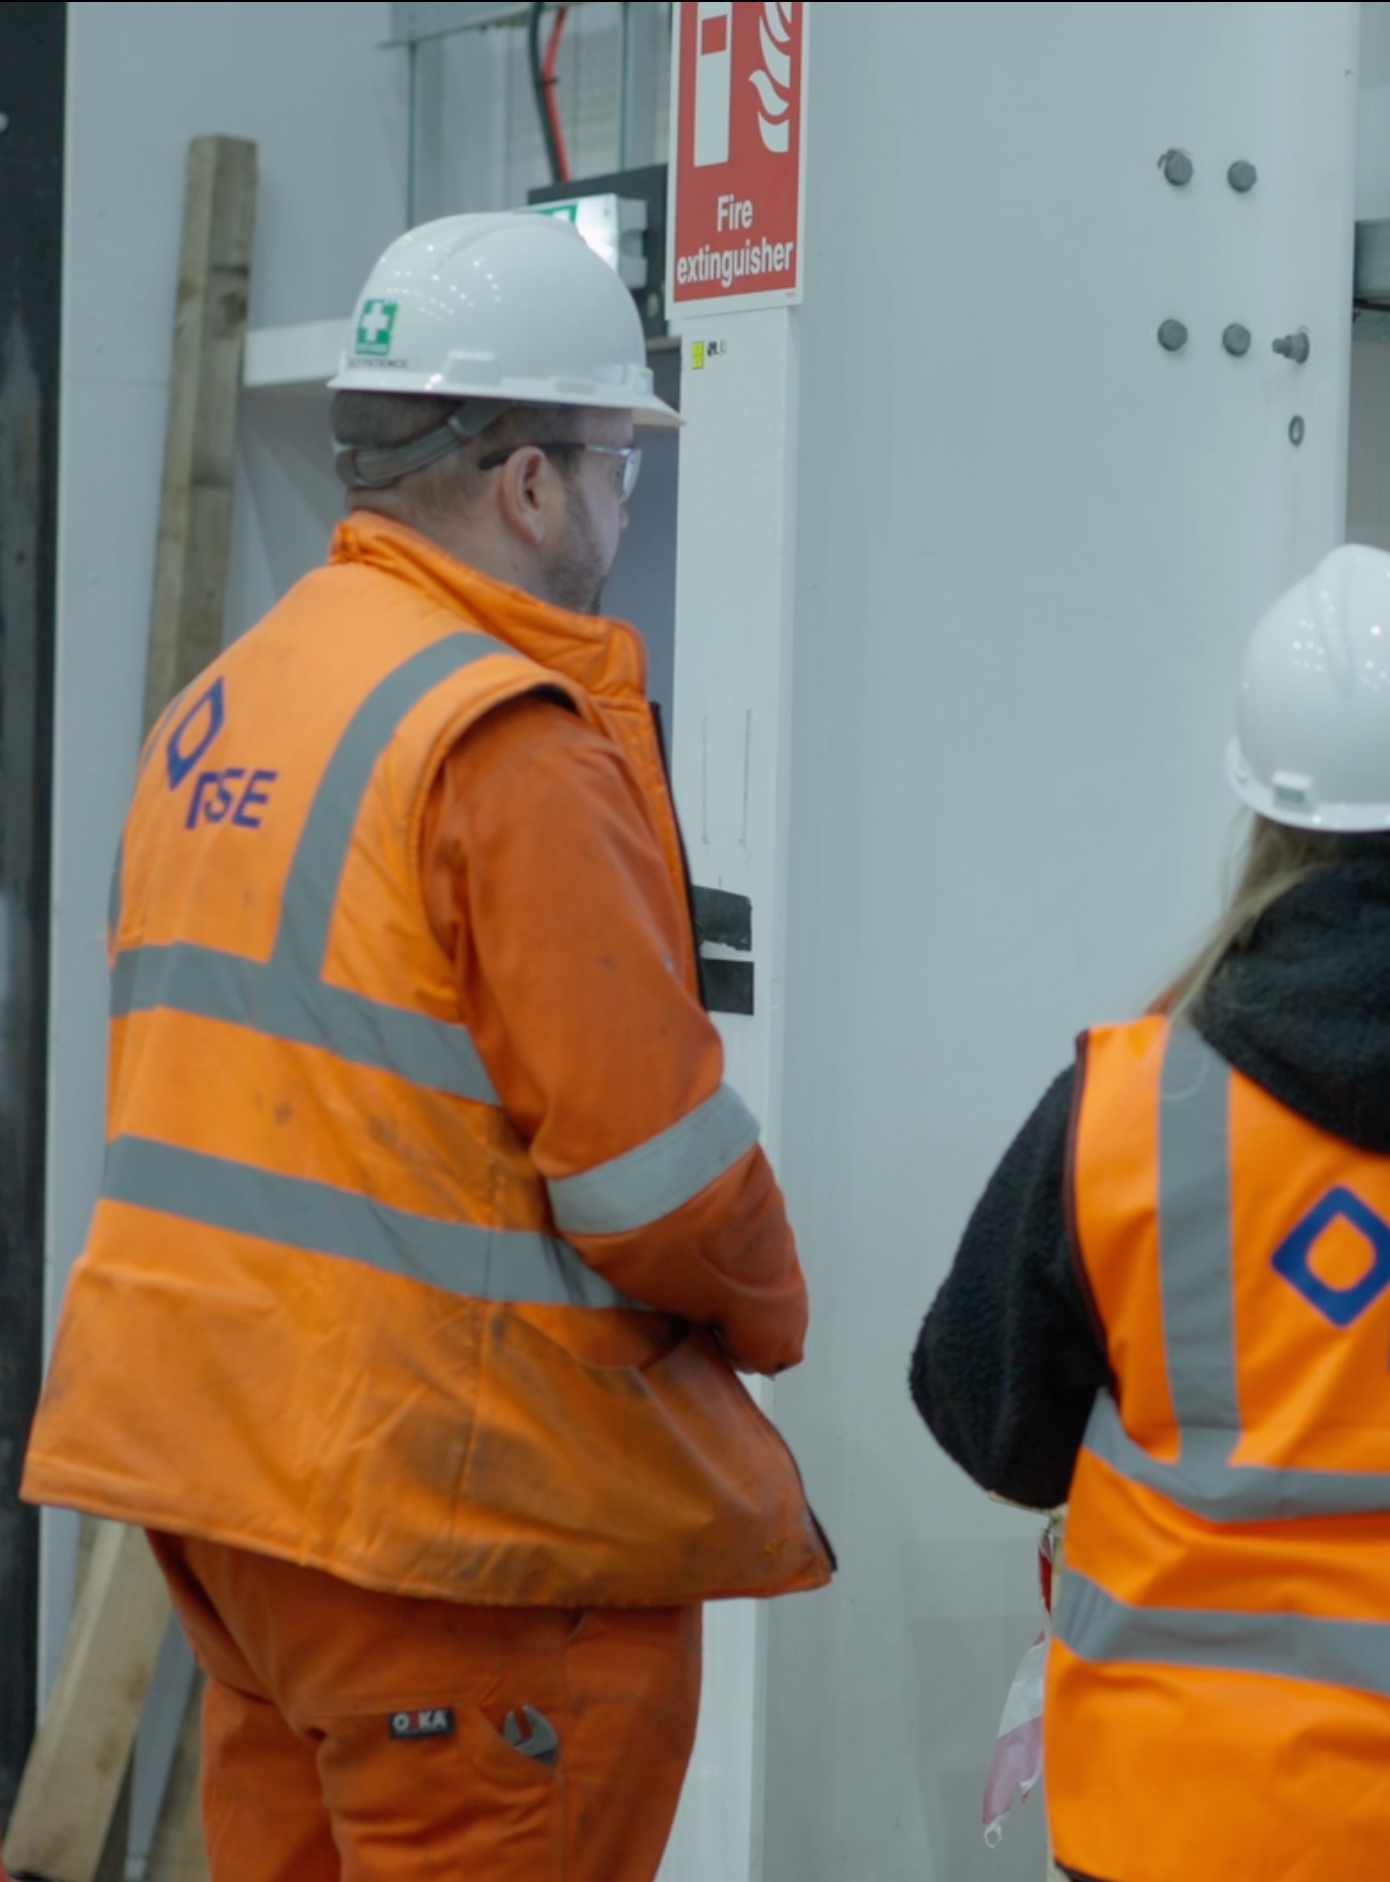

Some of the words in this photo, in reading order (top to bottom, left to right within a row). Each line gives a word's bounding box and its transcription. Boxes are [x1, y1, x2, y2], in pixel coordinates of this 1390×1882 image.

[717, 194, 753, 232] Fire
[677, 237, 793, 287] extinguisher
[392, 1711, 448, 1731] OKA
